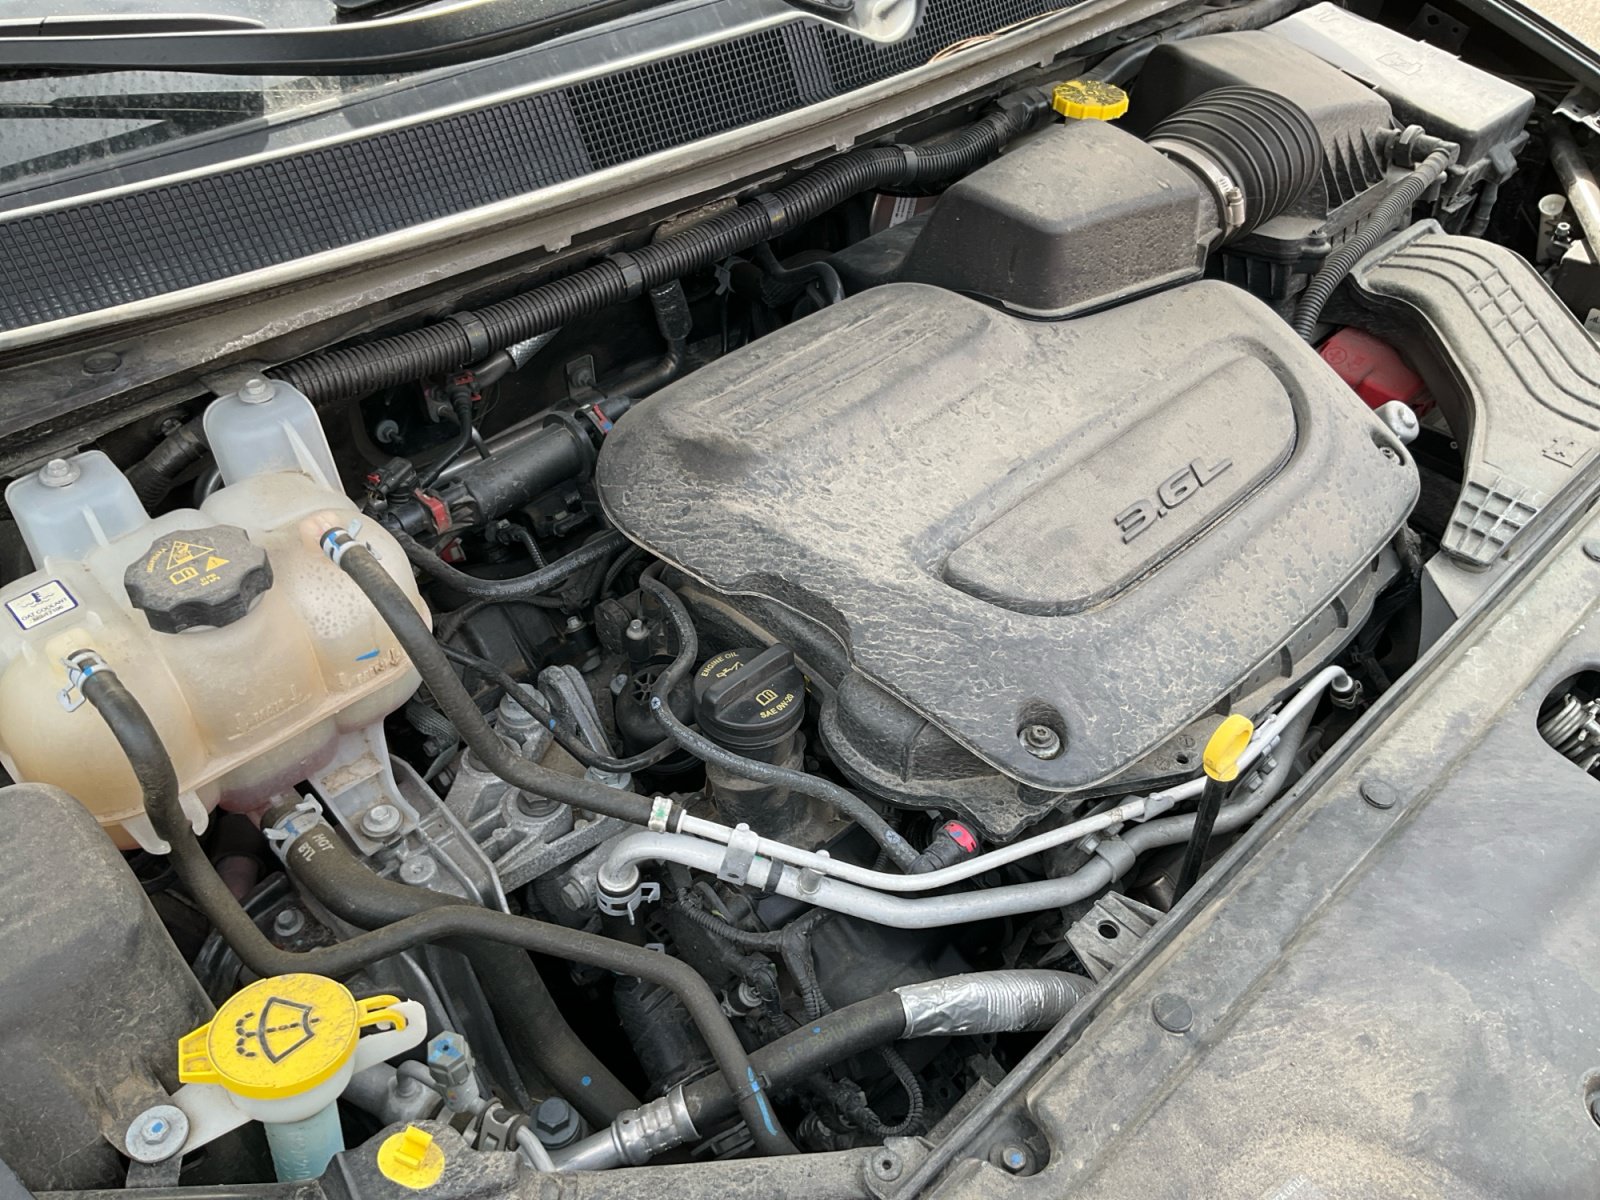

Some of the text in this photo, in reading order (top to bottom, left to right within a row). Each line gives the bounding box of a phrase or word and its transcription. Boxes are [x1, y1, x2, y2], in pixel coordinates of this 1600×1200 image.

[1114, 457, 1233, 544] 3.6L
[35, 597, 67, 614] COOLANT
[701, 651, 740, 677] ENGINE OIL
[759, 707, 778, 719] SAE
[312, 833, 335, 851] HOT
